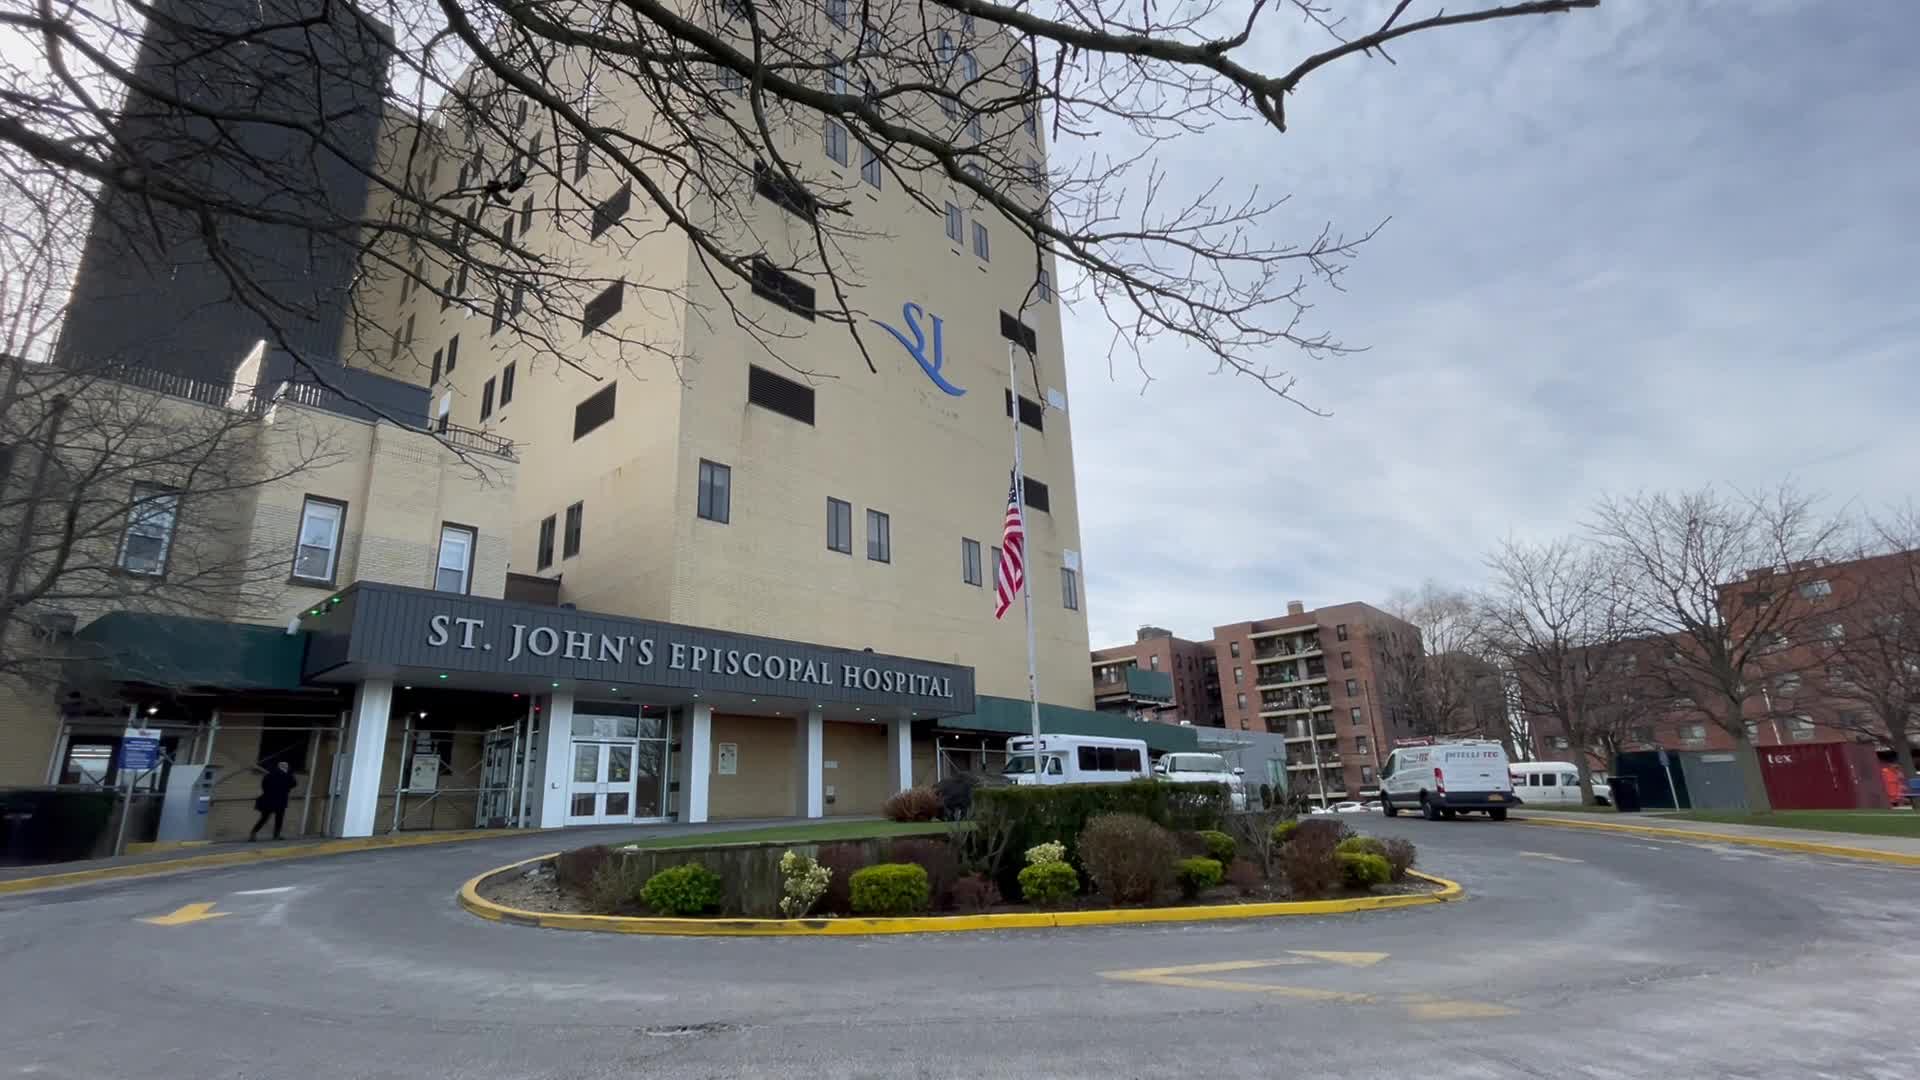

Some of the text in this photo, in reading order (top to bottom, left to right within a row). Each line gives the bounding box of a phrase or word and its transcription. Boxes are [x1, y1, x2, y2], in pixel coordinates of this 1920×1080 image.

[427, 615, 953, 698] ST. JOHN'S EPISCOPAL HOSPITAL
[1767, 753, 1793, 764] tex
